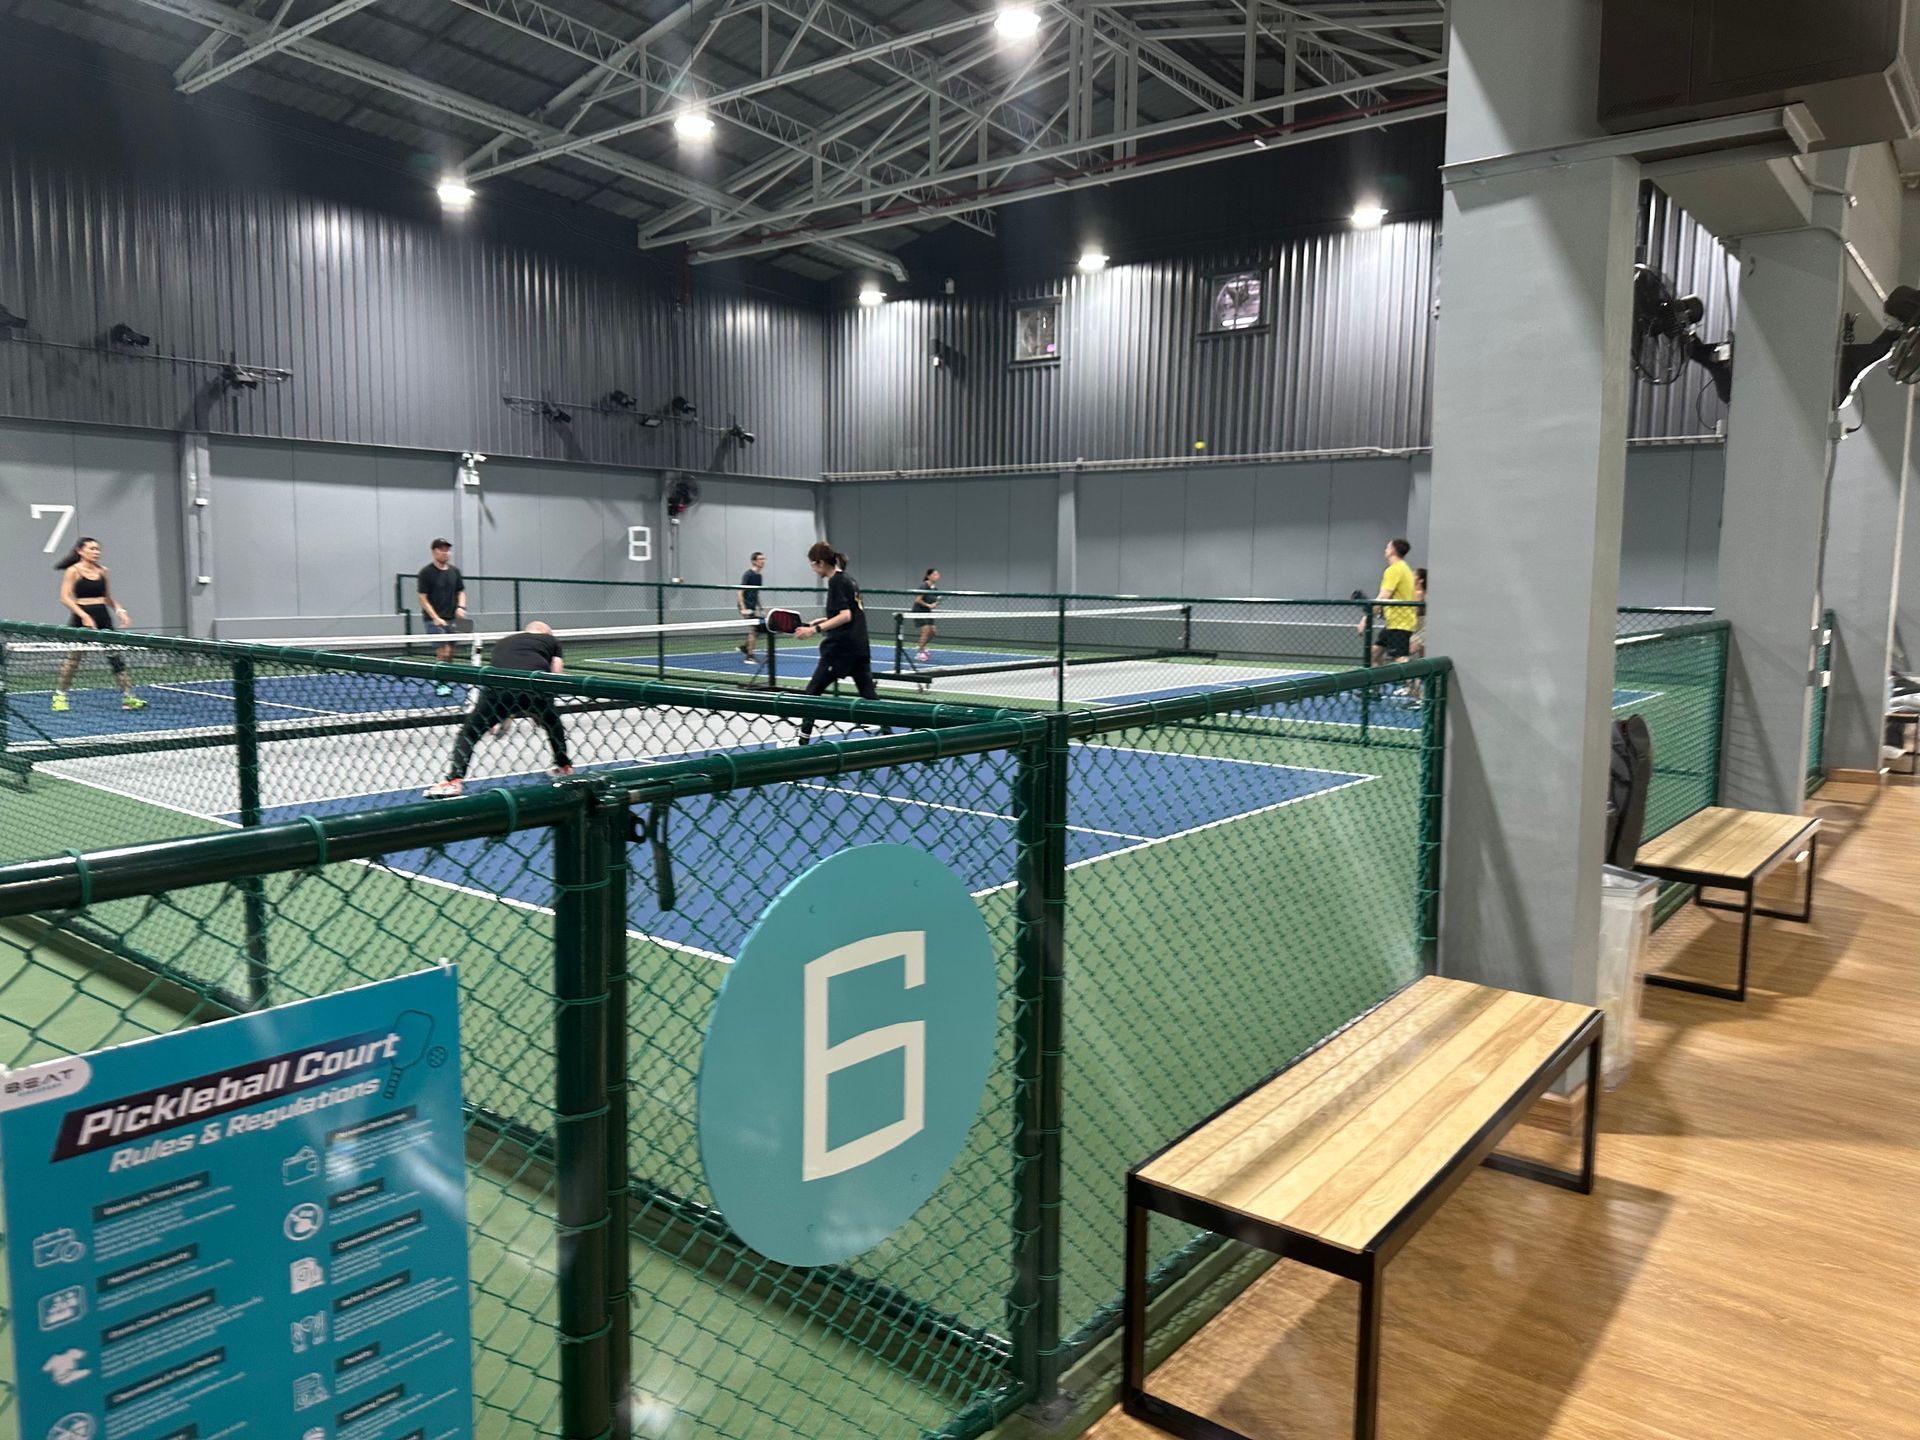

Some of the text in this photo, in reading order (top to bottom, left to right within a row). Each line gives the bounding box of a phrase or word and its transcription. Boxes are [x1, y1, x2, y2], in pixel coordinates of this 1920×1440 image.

[30, 503, 75, 553] 7
[628, 525, 652, 561] 8
[4, 1068, 75, 1094] BEAT
[76, 1060, 290, 1146] Pickleball
[293, 1032, 401, 1084] Court
[803, 930, 926, 1182] 6
[108, 1133, 196, 1173] Rules
[199, 1121, 222, 1145] &
[225, 1077, 382, 1138] Regulations
